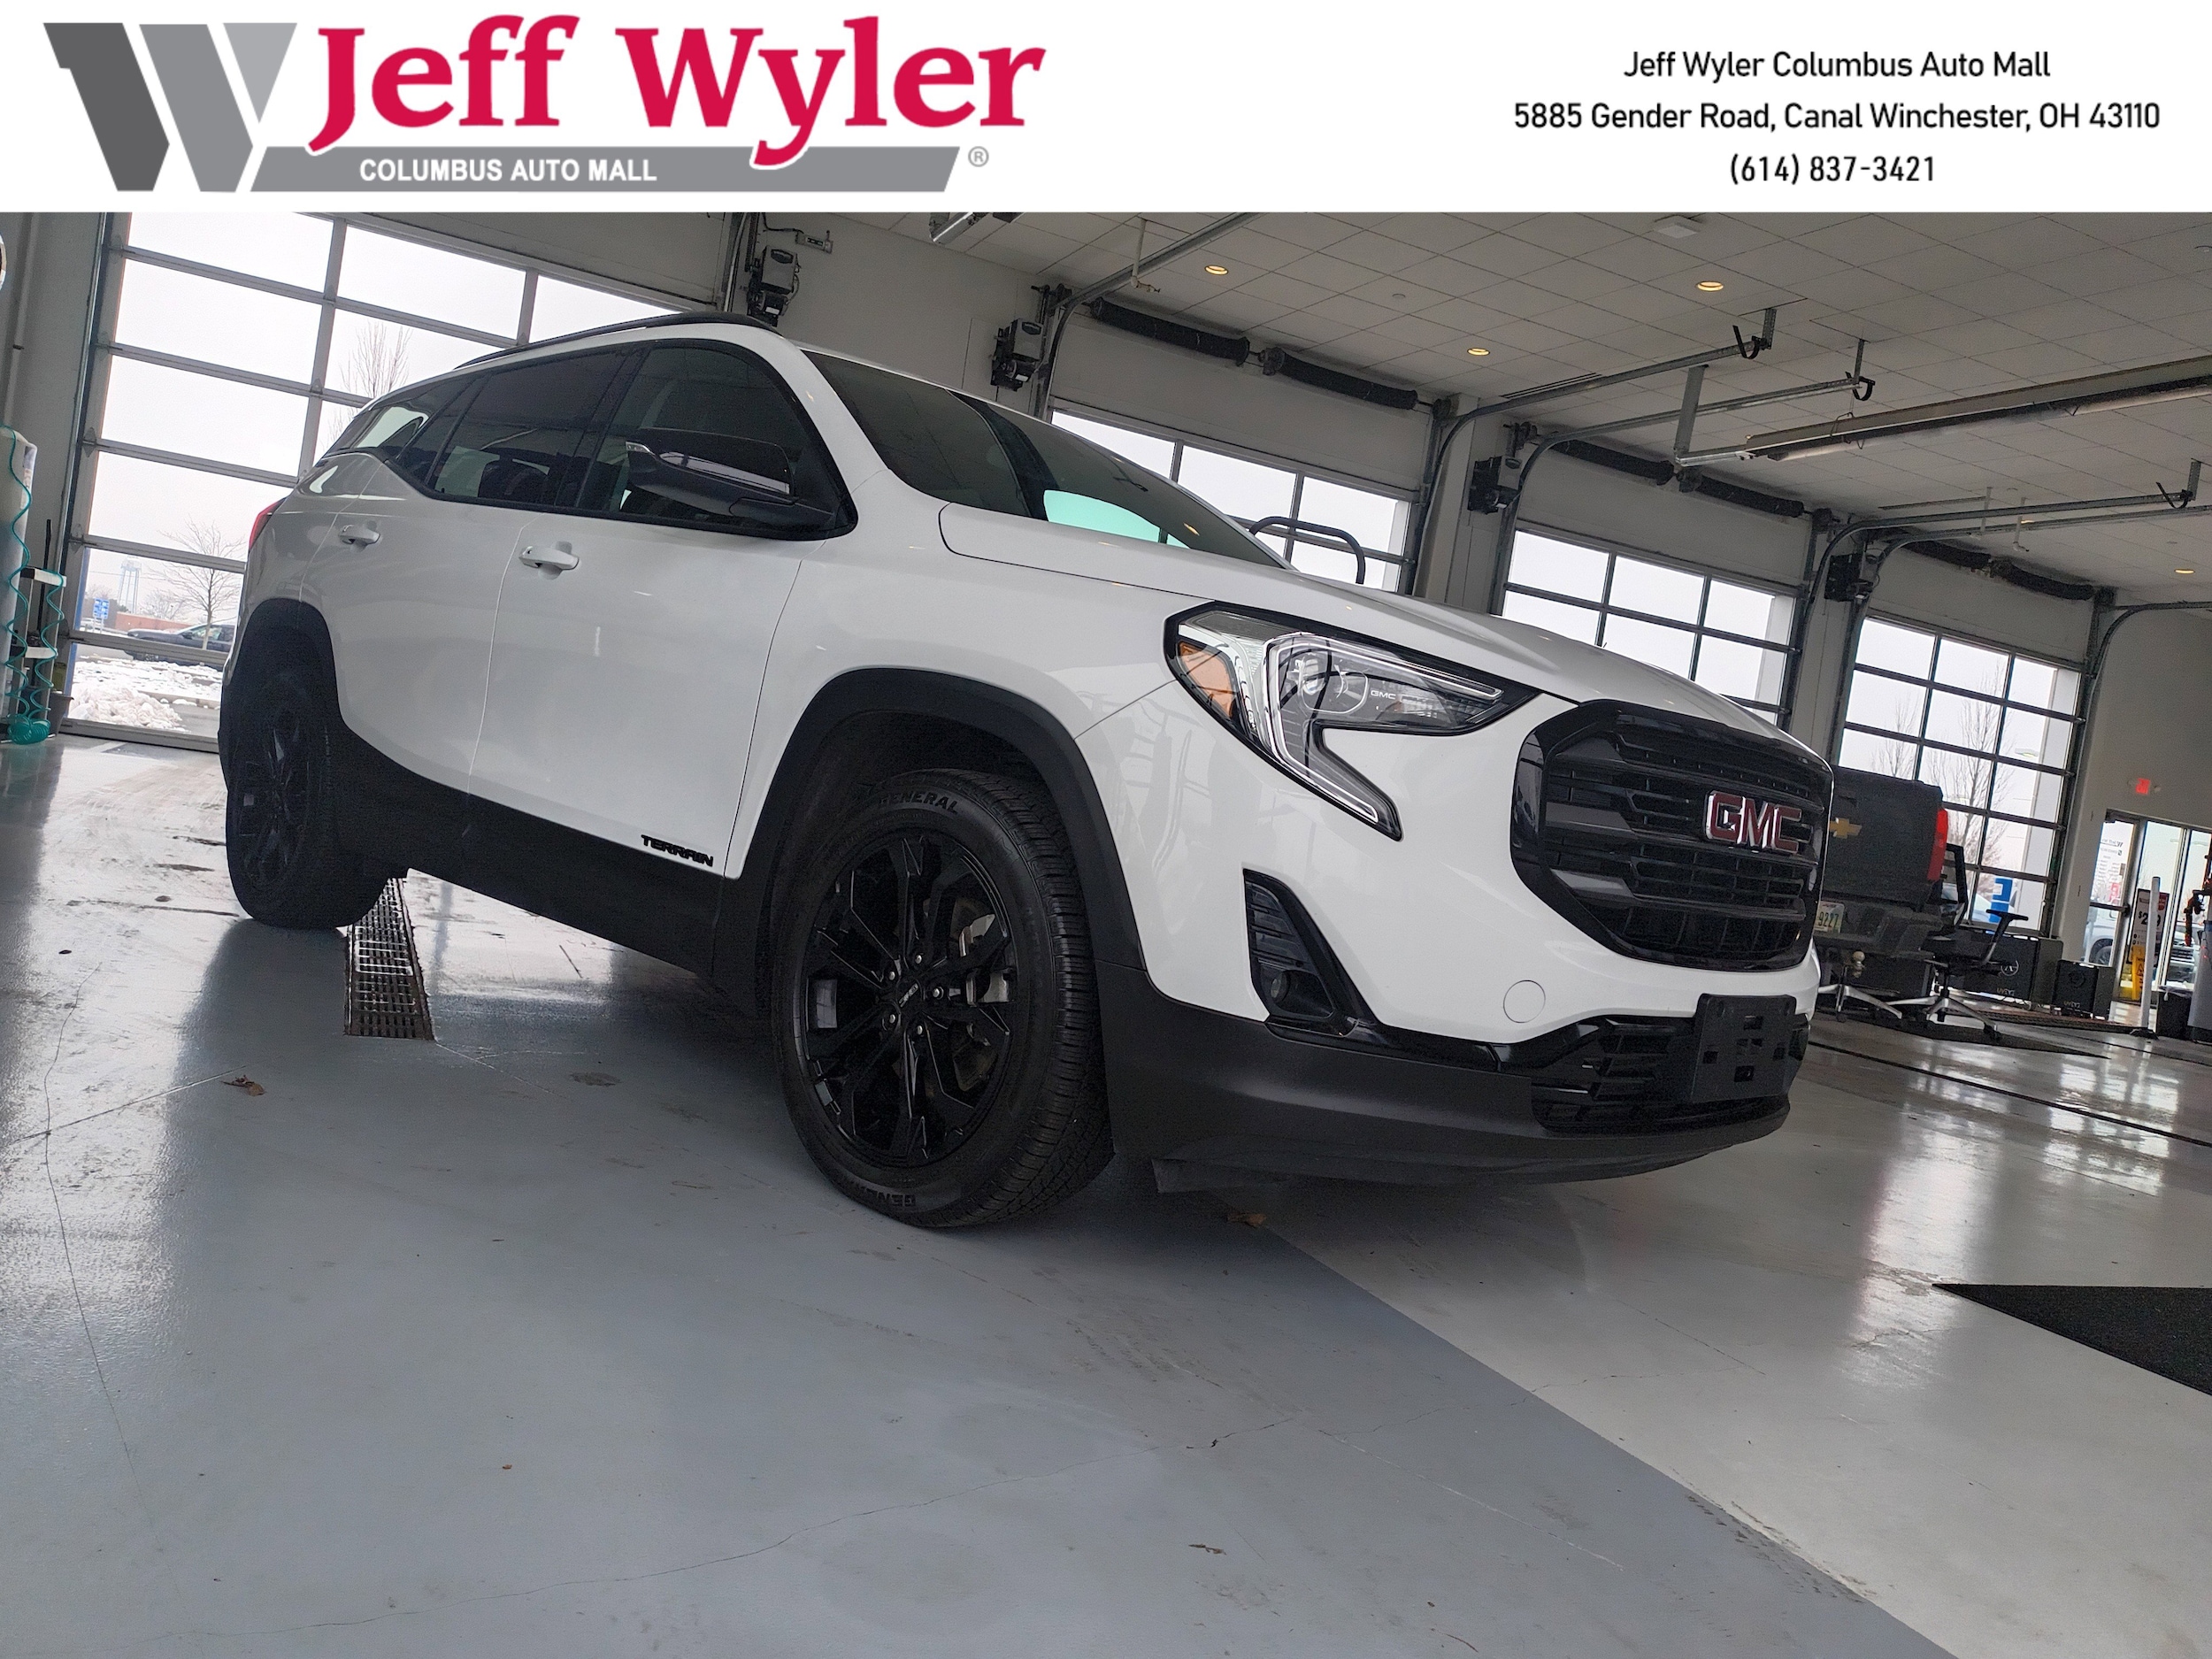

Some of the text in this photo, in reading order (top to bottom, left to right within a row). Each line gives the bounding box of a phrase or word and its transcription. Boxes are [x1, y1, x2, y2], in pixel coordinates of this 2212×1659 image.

[1371, 690, 1396, 700] GMC
[1705, 790, 1805, 854] GMC
[641, 834, 714, 868] TERRAIN
